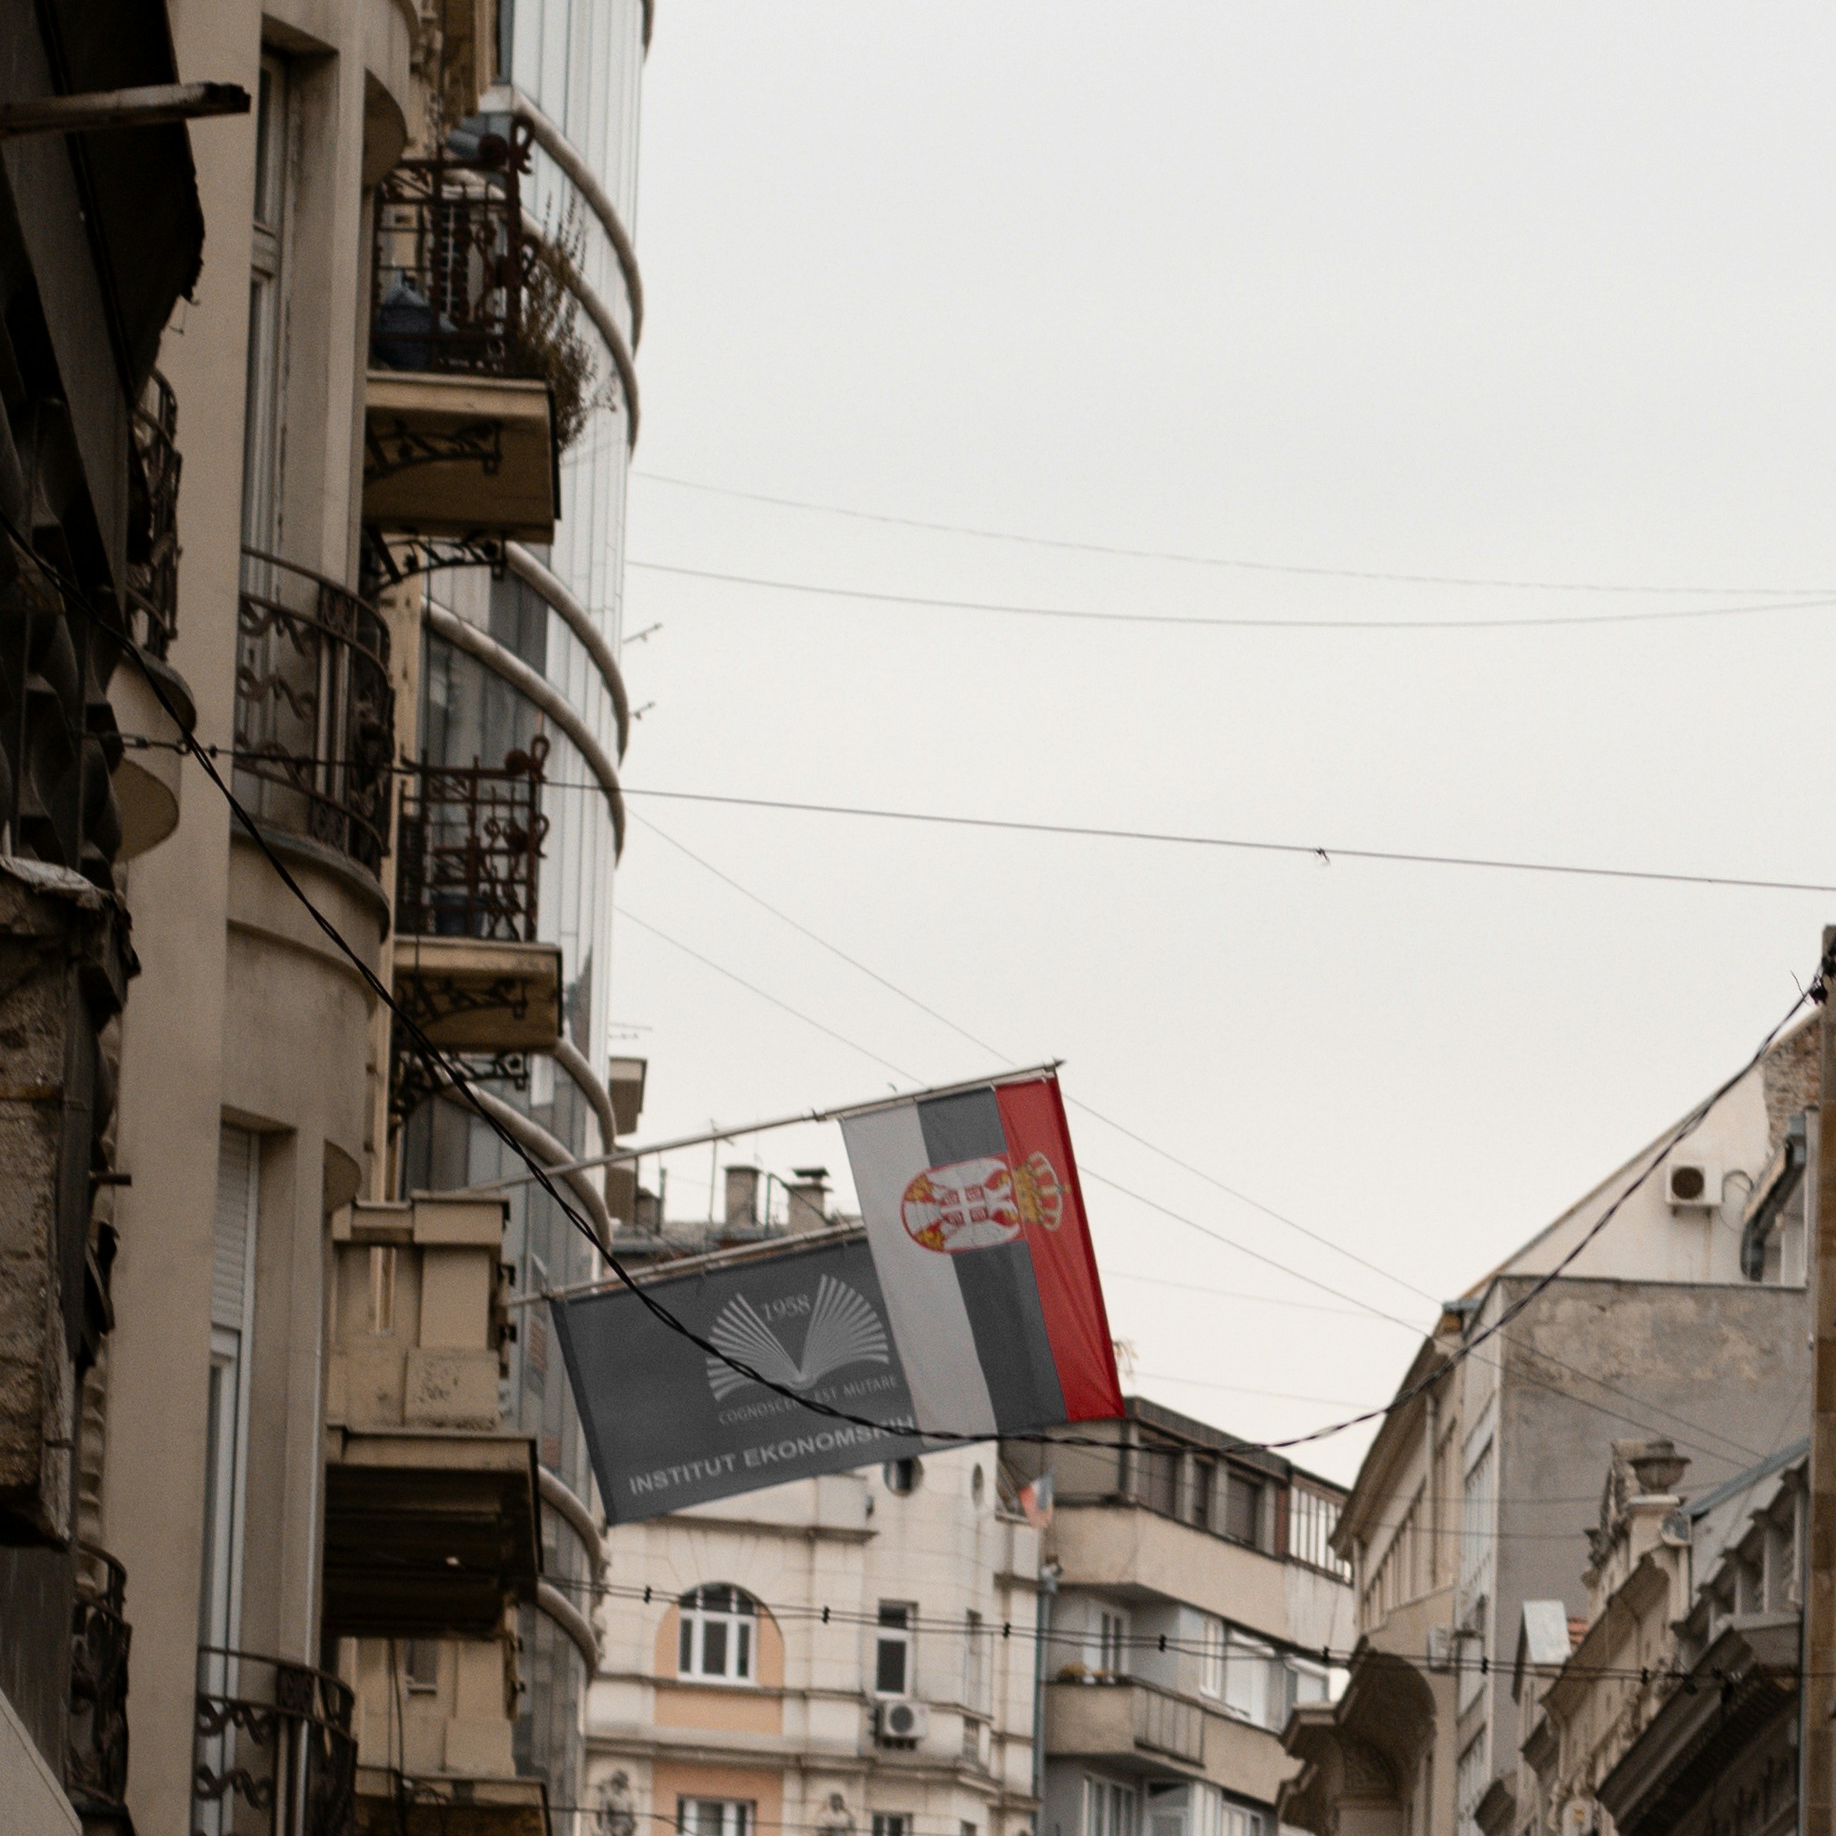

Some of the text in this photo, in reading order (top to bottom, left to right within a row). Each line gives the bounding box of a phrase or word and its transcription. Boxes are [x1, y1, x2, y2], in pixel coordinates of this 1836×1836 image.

[761, 1293, 811, 1322] 1958
[718, 1374, 898, 1426] COGNOSCER EST MUTARE
[629, 1415, 914, 1495] INSTITUT EKONOMSKIH
